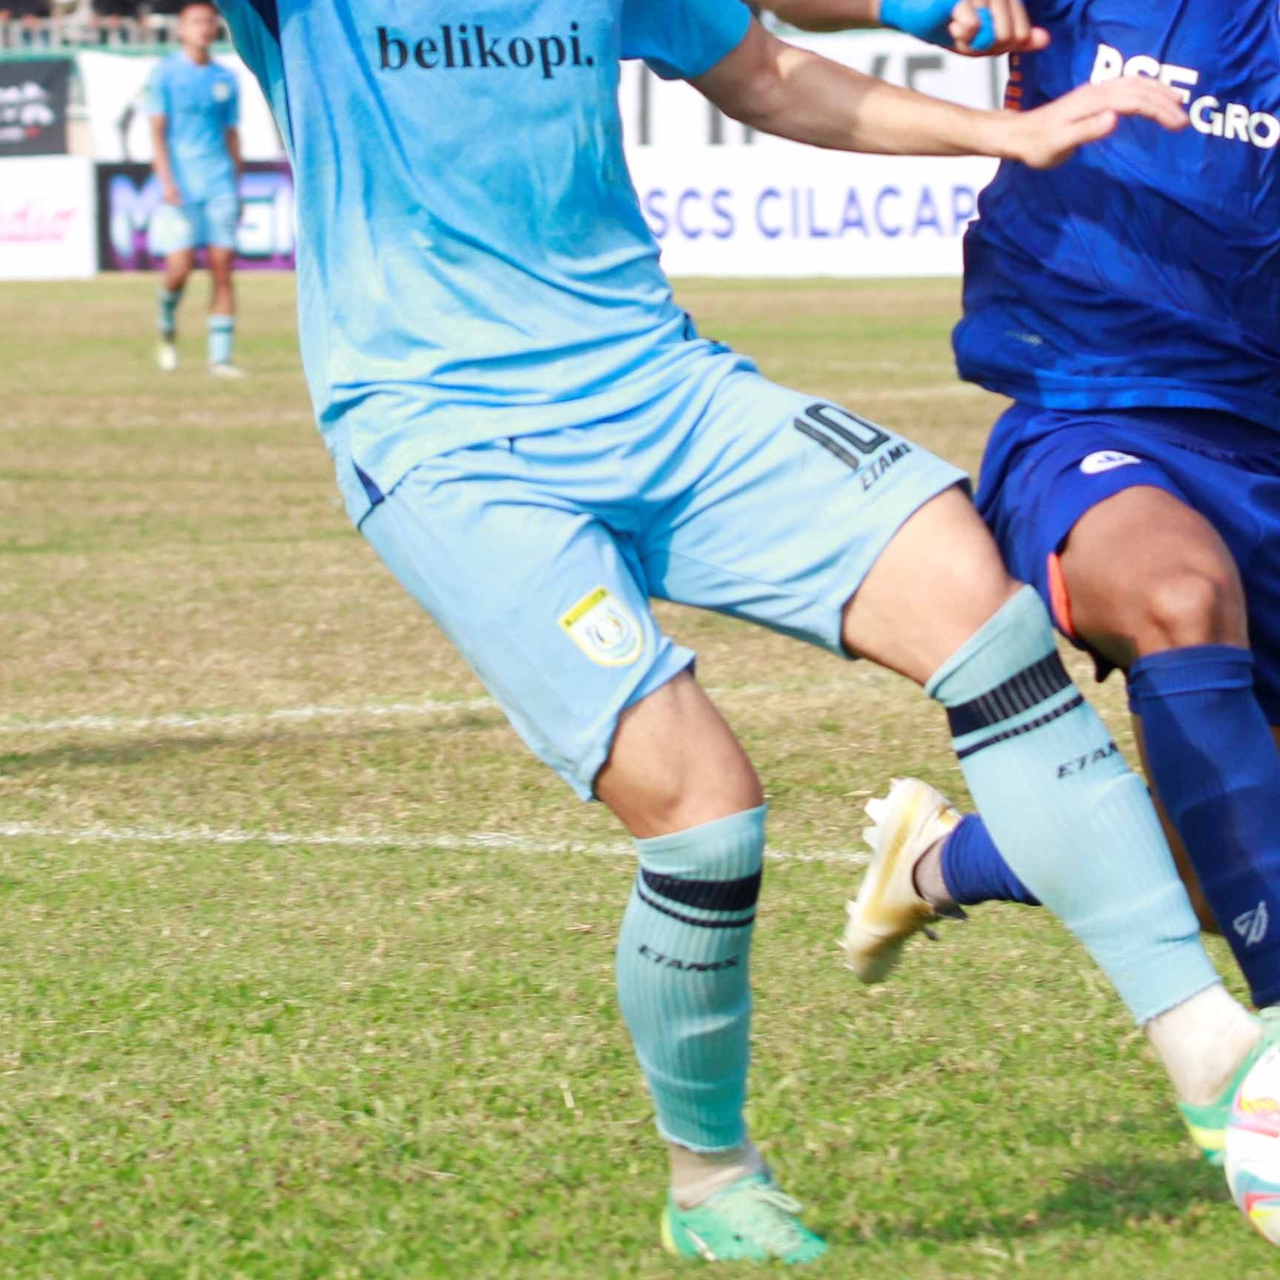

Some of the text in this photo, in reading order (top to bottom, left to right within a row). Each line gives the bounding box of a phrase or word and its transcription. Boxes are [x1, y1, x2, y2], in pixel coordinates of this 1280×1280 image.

[376, 21, 594, 79] belikopi.
[755, 185, 977, 239] CILACAP
[793, 403, 891, 471] 10
